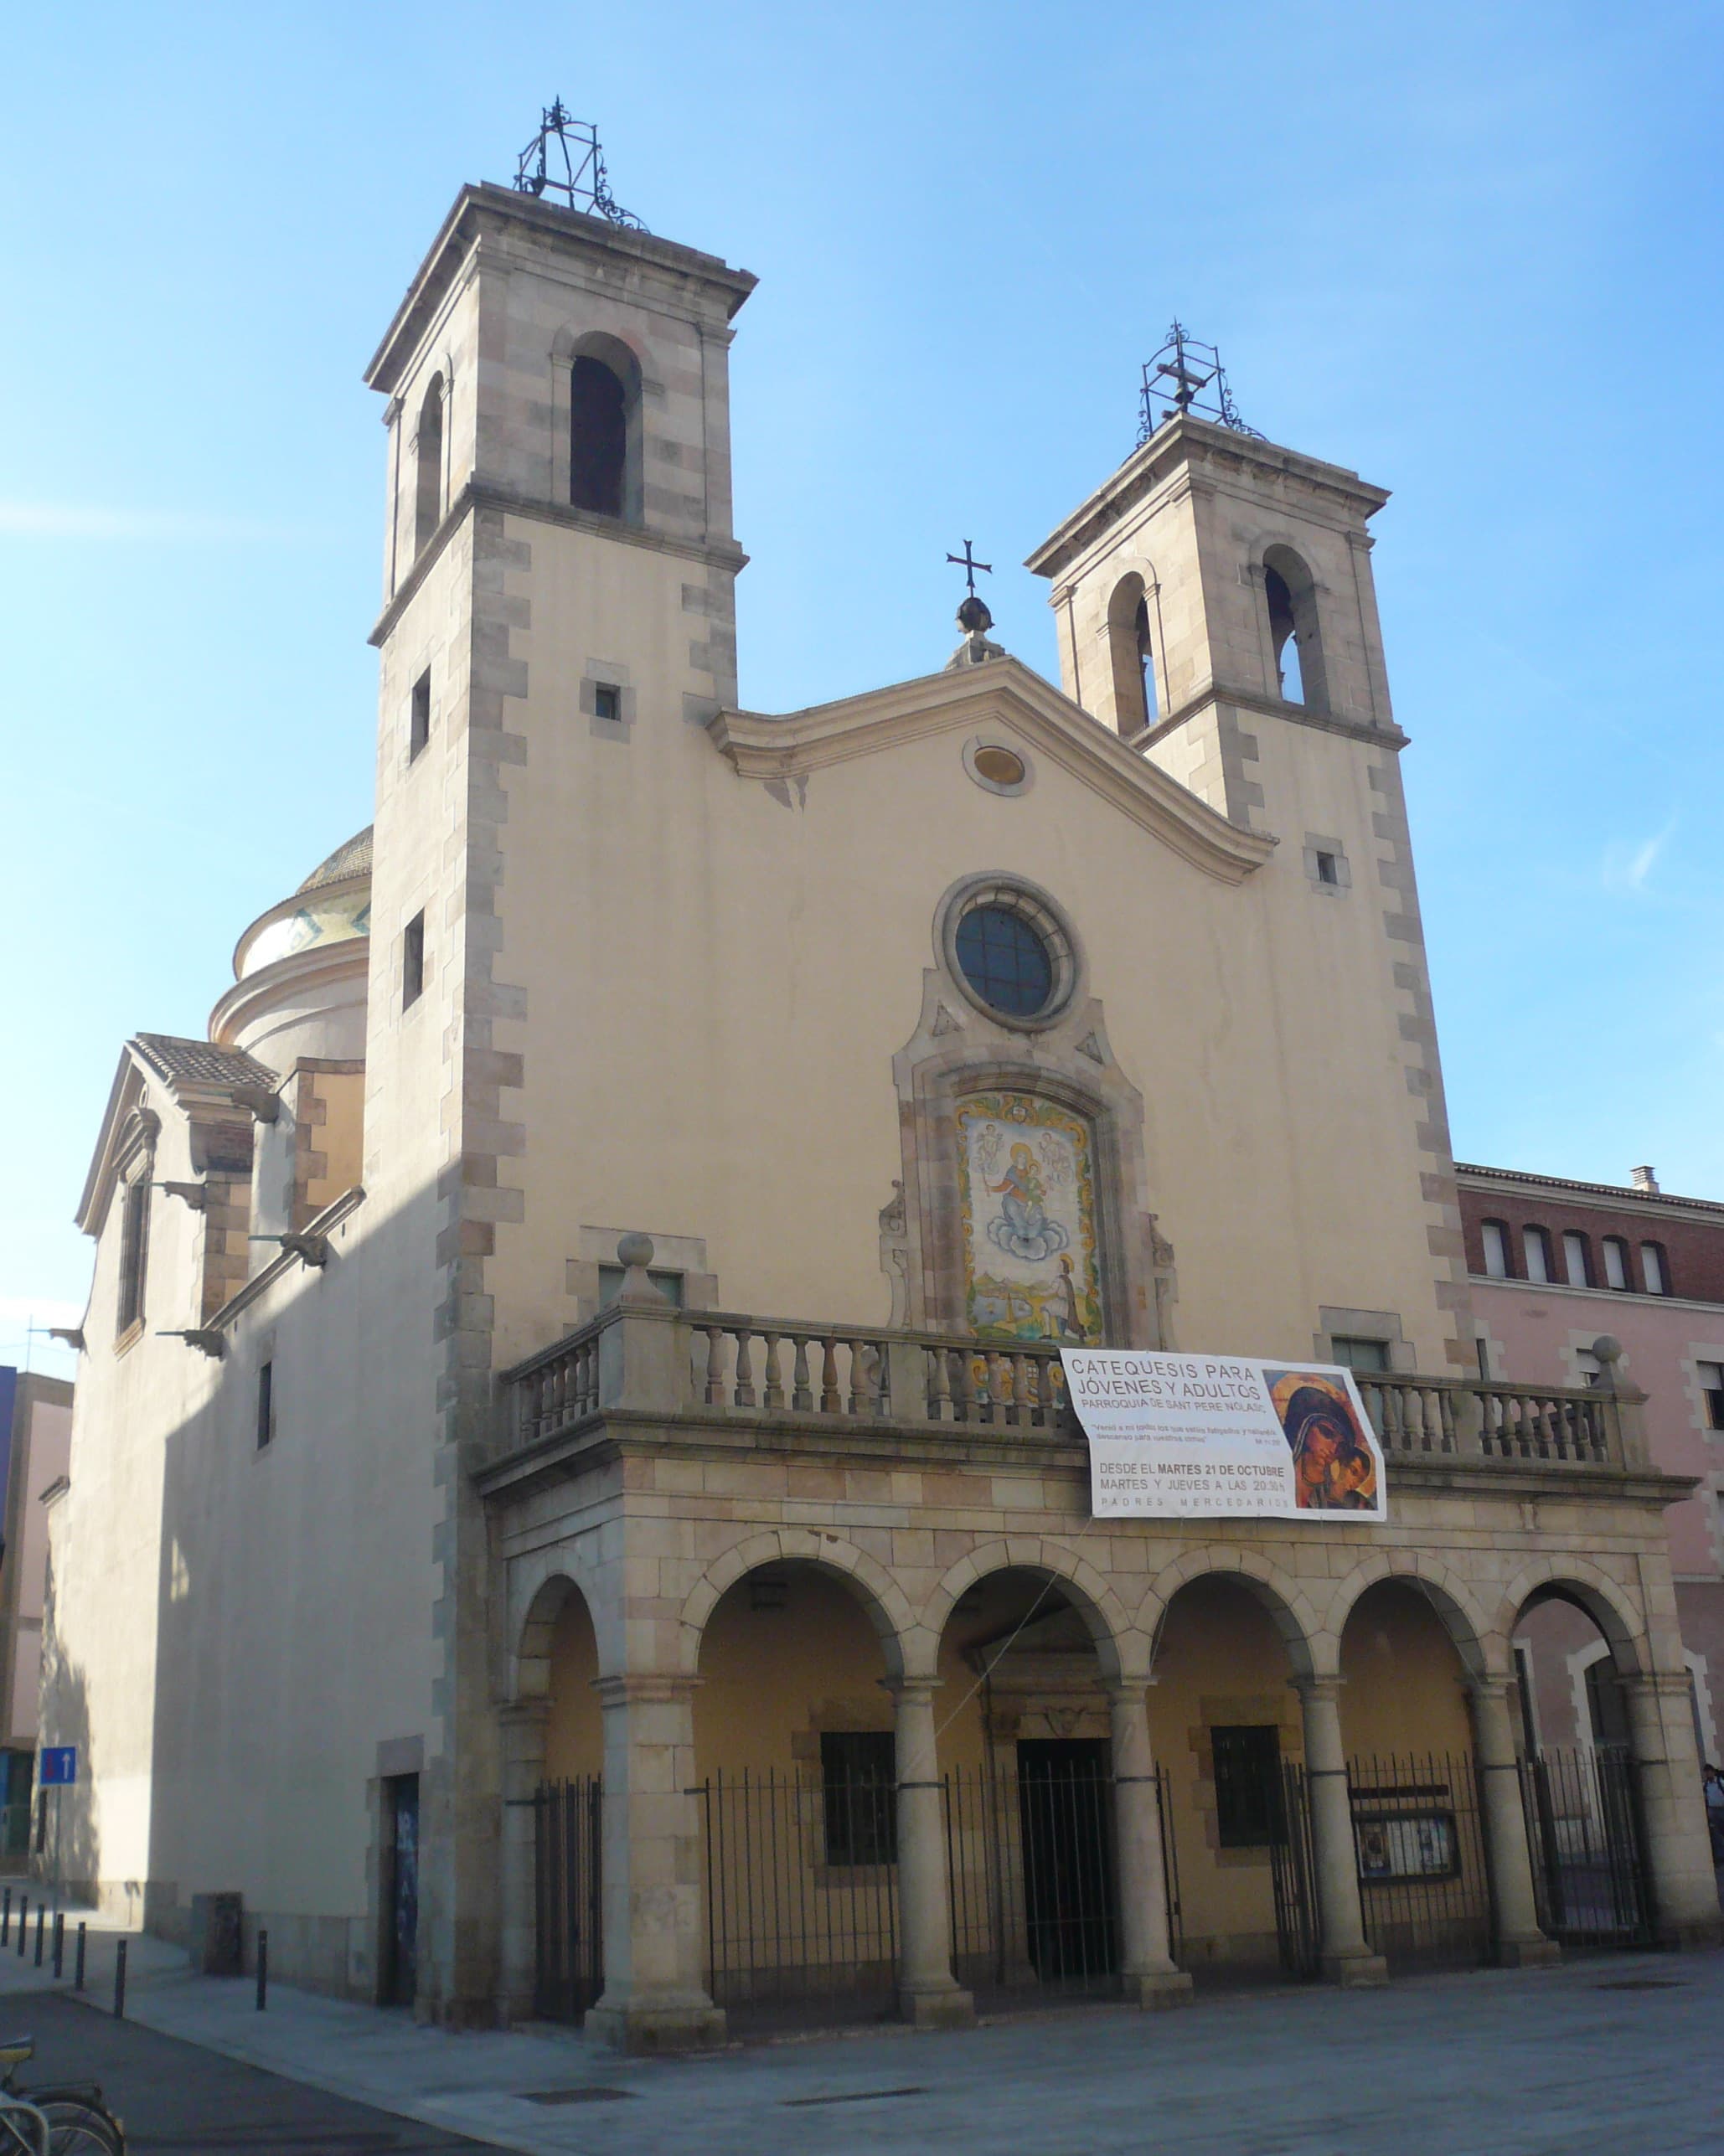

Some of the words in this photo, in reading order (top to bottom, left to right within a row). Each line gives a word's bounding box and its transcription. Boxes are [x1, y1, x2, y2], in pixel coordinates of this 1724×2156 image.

[1072, 1359, 1198, 1379] CATEQUESIS
[1205, 1364, 1256, 1381] PARA
[1078, 1376, 1163, 1395] JÓVENES
[1165, 1381, 1174, 1395] Y
[1183, 1383, 1261, 1400] ADULTOS
[1081, 1399, 1149, 1409] PARROQUIA
[1150, 1398, 1164, 1409] DE
[1165, 1400, 1191, 1411] SANT
[1194, 1401, 1224, 1412] PERE
[1100, 1462, 1138, 1474] DESDE
[1140, 1463, 1155, 1475] EL
[1158, 1463, 1202, 1475] MARTES
[1205, 1464, 1216, 1475] 21
[1219, 1464, 1235, 1475] DE
[1237, 1464, 1285, 1478] OCTUBRE
[1100, 1478, 1148, 1490] MARTES
[1154, 1479, 1162, 1489] Y
[1168, 1479, 1210, 1491] JUEVES
[1215, 1480, 1223, 1491] A
[1228, 1480, 1247, 1491] LAS
[1102, 1497, 1164, 1507] PADRES
